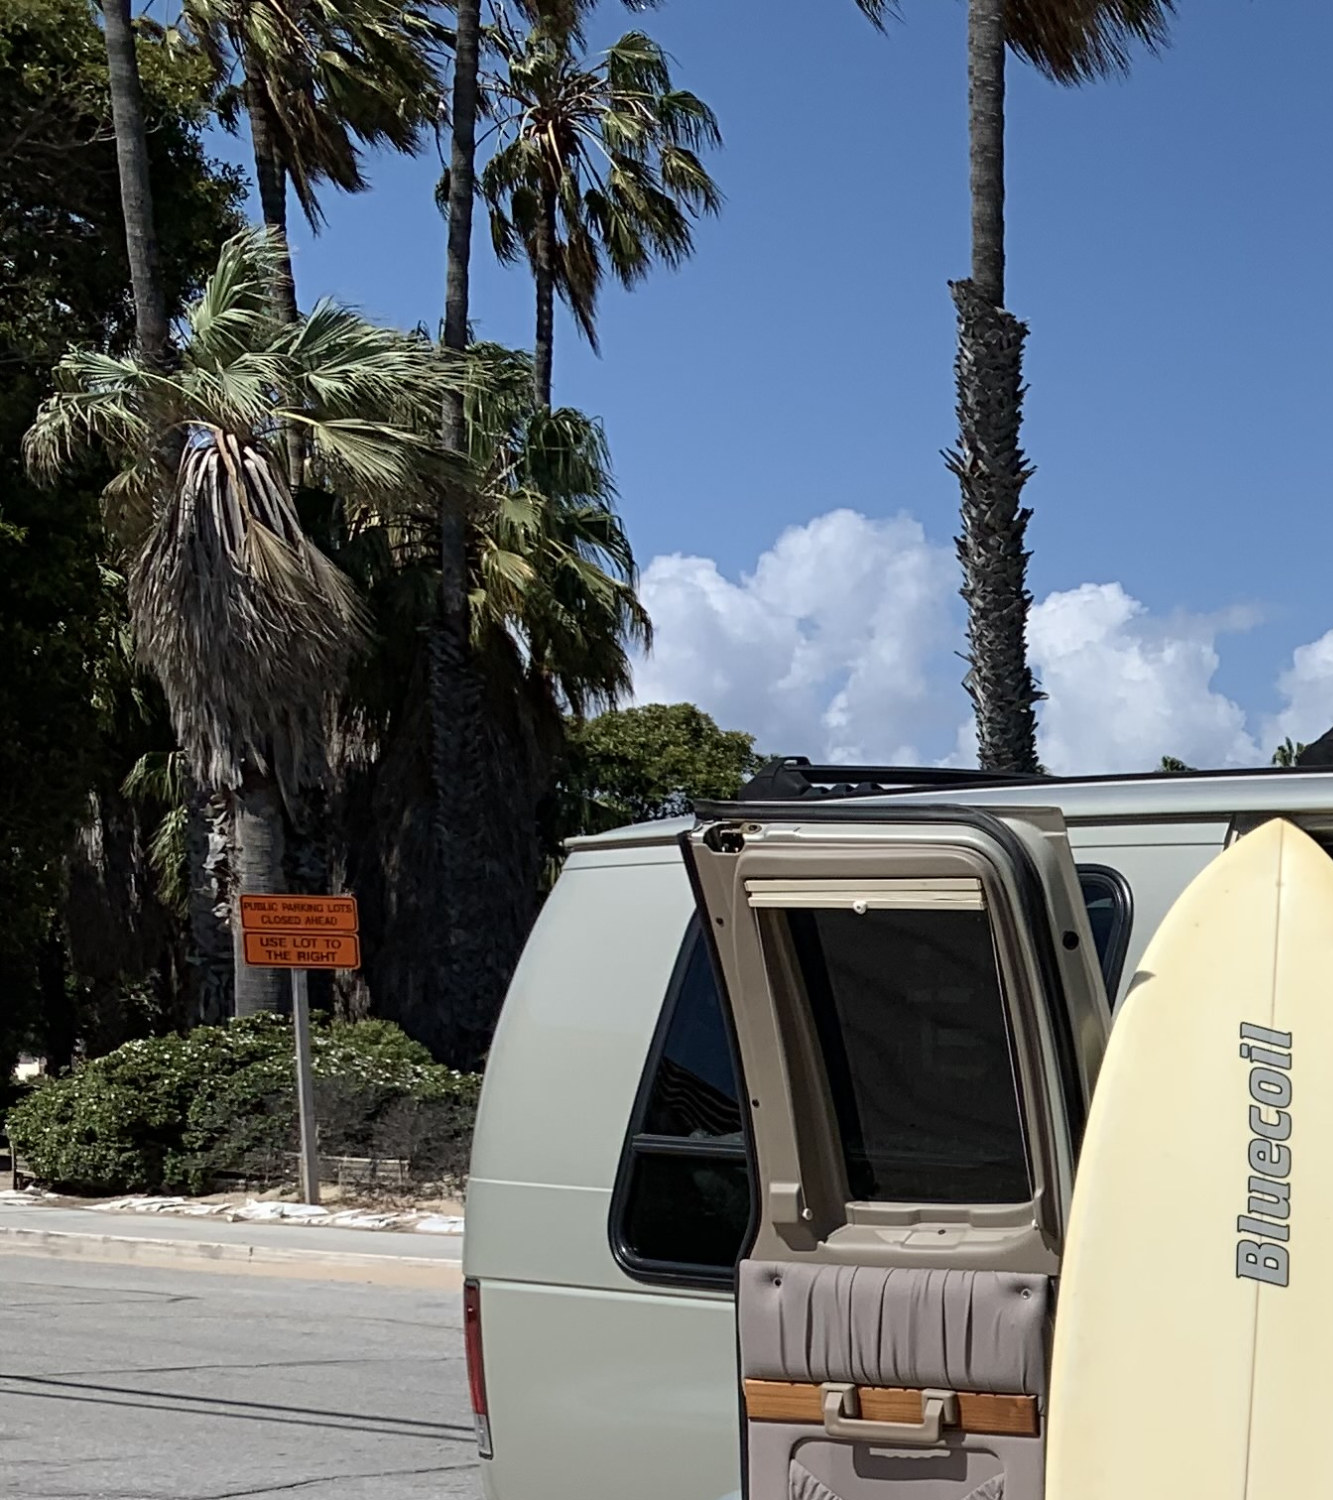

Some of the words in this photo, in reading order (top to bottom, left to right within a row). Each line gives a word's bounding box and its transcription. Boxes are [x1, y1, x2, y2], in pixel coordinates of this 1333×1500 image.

[243, 902, 278, 912] PUBLIC
[282, 903, 323, 913] PARKING
[327, 904, 352, 913] LOTS
[261, 915, 301, 925] CLOSED
[305, 916, 337, 926] AHEAD
[260, 937, 286, 948] USE
[292, 938, 318, 949] LOT
[324, 939, 342, 949] TO
[265, 950, 291, 961] THE
[297, 951, 337, 962] RIGHT
[1236, 1021, 1292, 1287] Bluecoil
